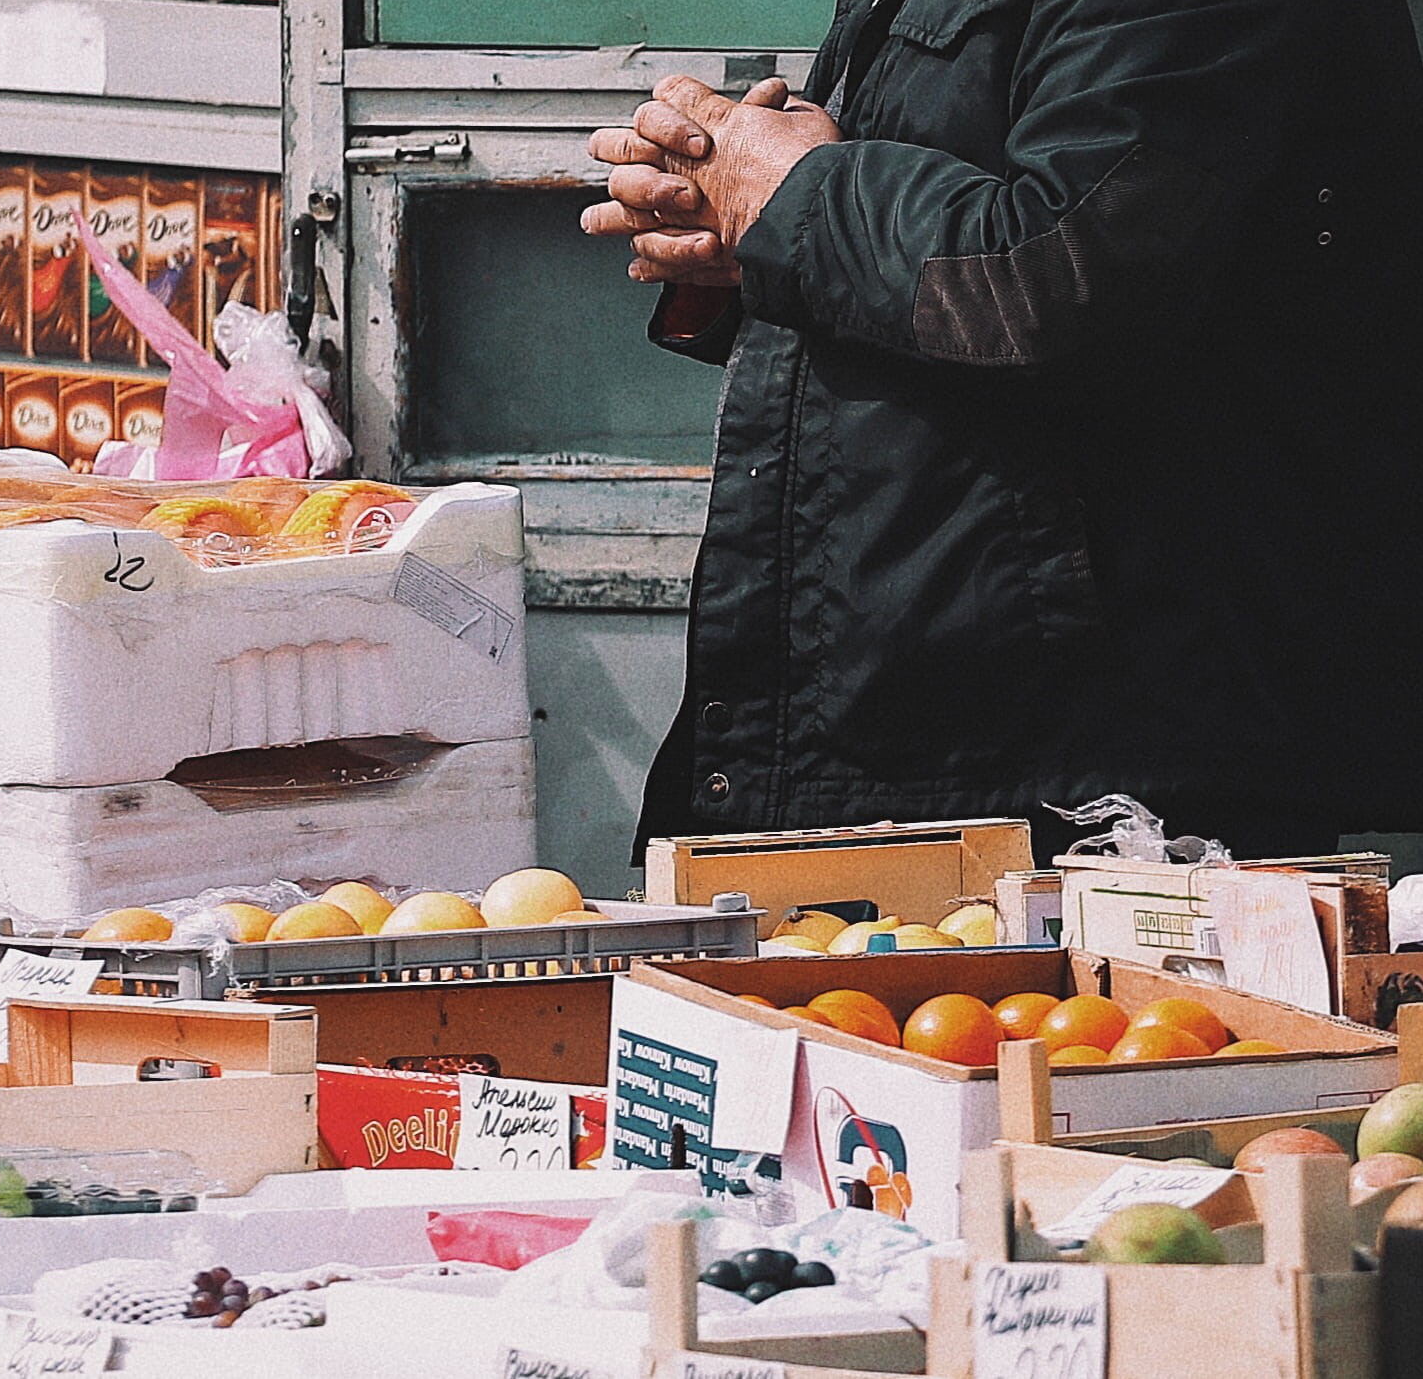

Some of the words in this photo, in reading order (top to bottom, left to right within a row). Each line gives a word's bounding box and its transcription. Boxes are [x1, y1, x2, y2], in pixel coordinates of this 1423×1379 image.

[33, 203, 75, 233] Dove
[89, 208, 138, 237] Dove
[147, 214, 193, 243] Dove
[72, 406, 106, 435] Dove
[472, 1078, 558, 1113] Апельсин
